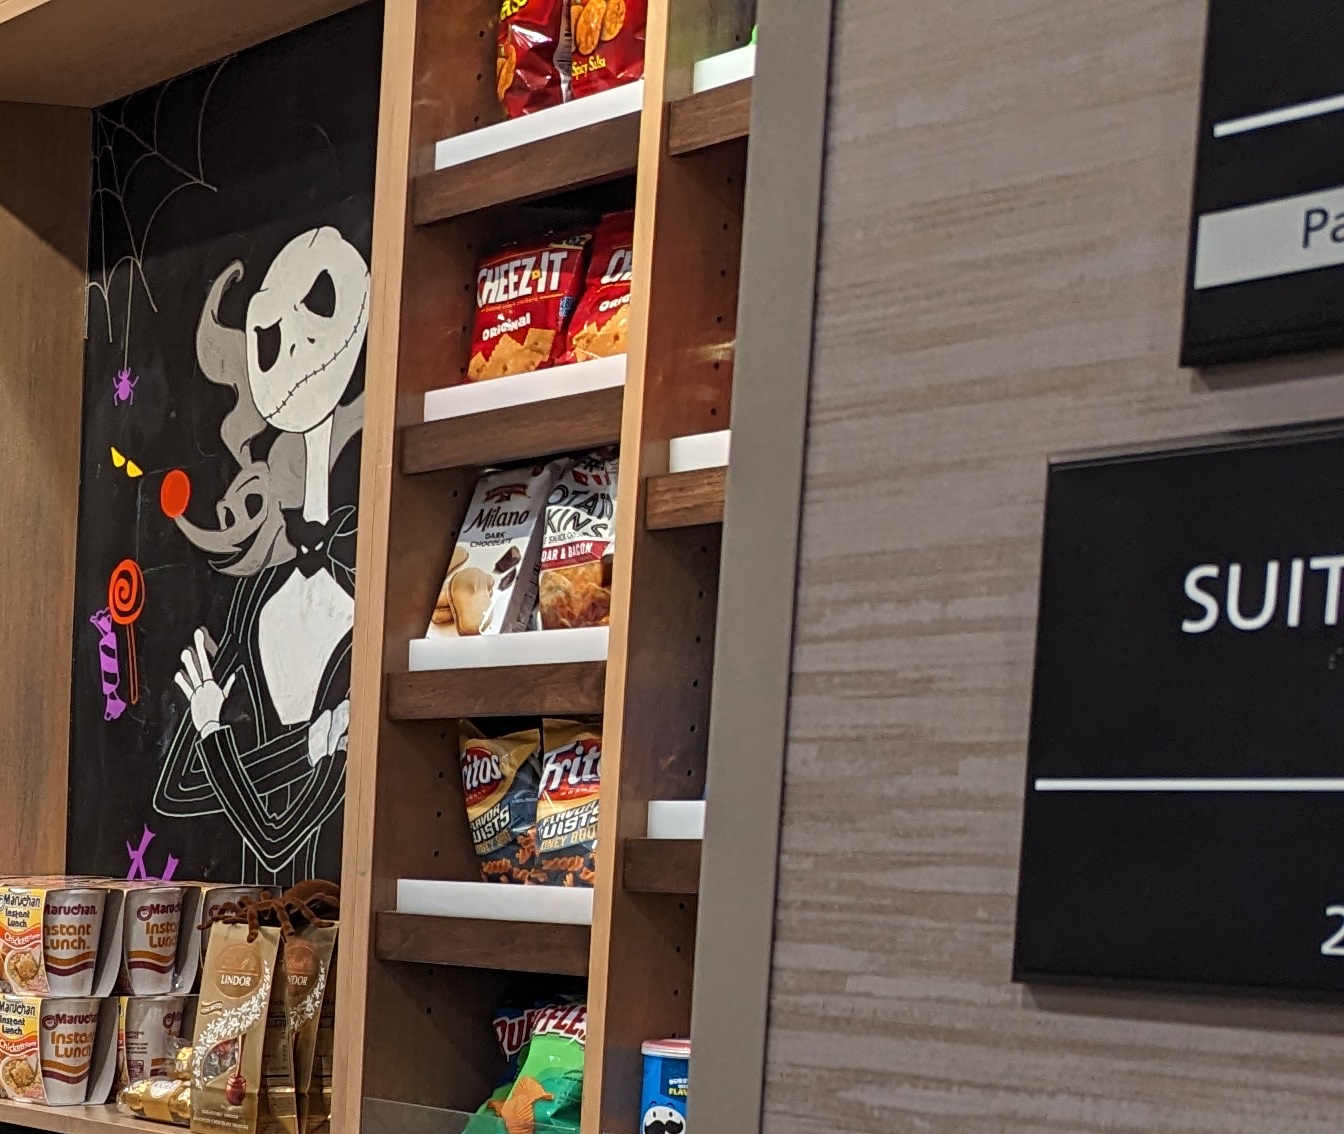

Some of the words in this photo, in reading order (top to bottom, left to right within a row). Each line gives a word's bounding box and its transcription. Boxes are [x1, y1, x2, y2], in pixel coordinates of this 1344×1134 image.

[464, 506, 529, 533] Milano
[485, 531, 506, 539] DARK
[4, 894, 41, 907] Maruchan
[44, 923, 91, 936] nstant
[221, 974, 251, 987] LINDOR
[0, 1000, 36, 1015] Maruchan
